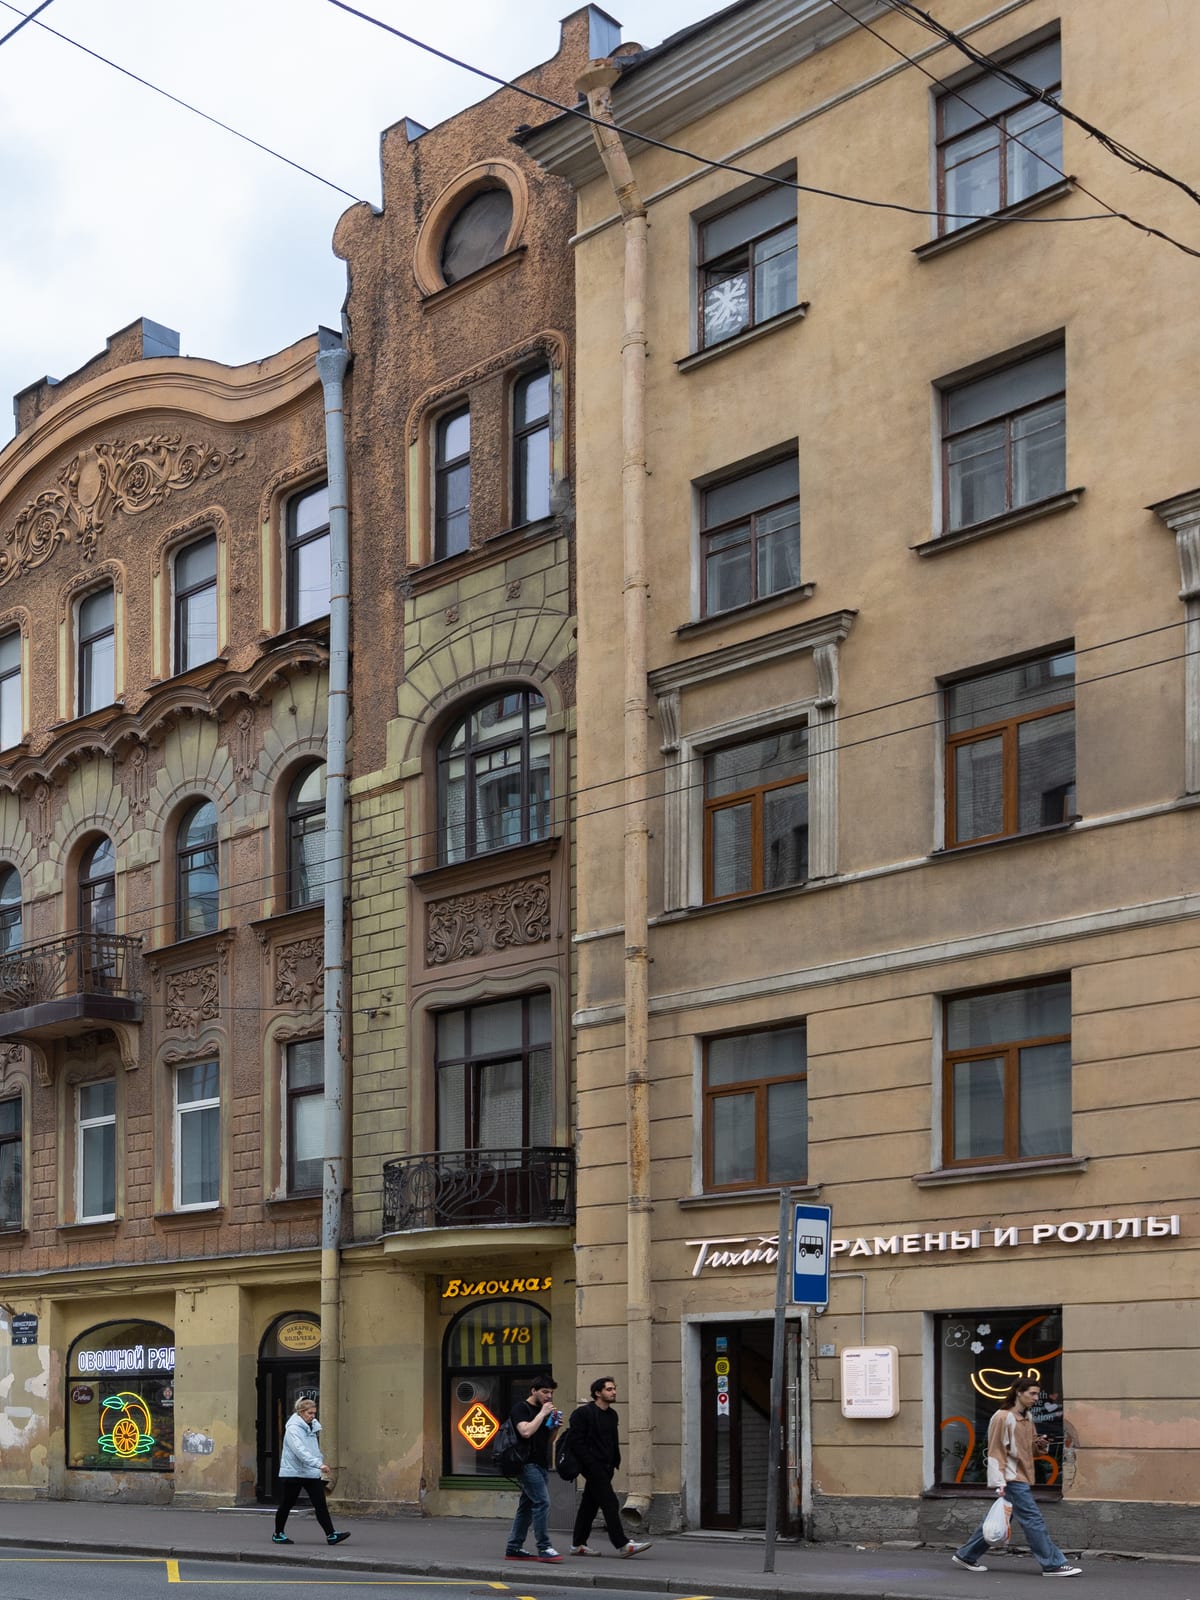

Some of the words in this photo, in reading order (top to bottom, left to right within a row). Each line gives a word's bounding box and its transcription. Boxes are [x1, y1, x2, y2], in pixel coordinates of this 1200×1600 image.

[831, 1229, 980, 1258] РАМЕНЫ
[994, 1226, 1018, 1247] И
[1032, 1215, 1180, 1244] РОЛЛЫ
[442, 1276, 552, 1297] Булочная
[502, 1327, 531, 1344] 118
[78, 1345, 144, 1372] ОВОЩНОЙ
[148, 1347, 176, 1371] РЯД
[466, 1424, 491, 1434] КОФЕ
